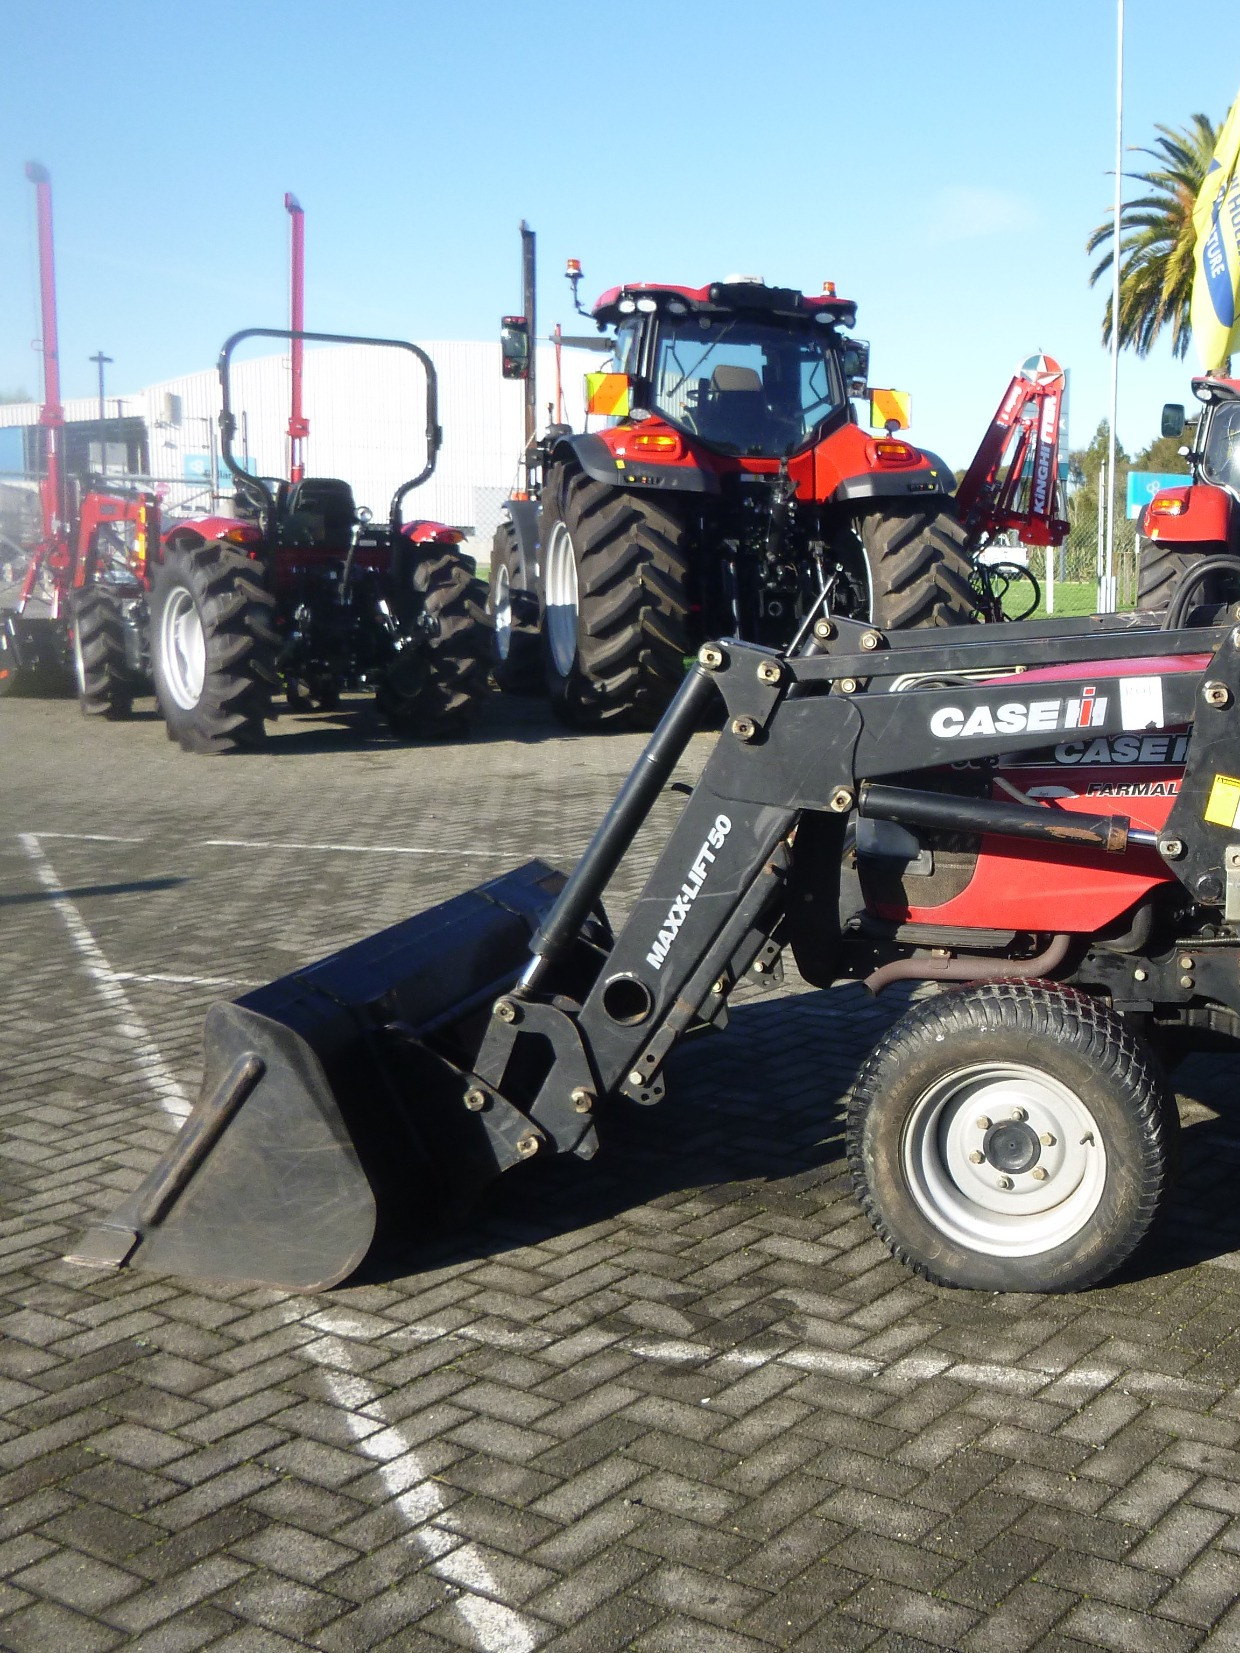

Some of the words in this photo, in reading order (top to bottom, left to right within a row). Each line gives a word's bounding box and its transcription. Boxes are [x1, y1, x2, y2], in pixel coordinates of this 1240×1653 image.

[931, 701, 1061, 738] CASE
[1055, 735, 1170, 764] CASE
[646, 841, 716, 970] MAXX-LIFT
[708, 814, 732, 849] 50
